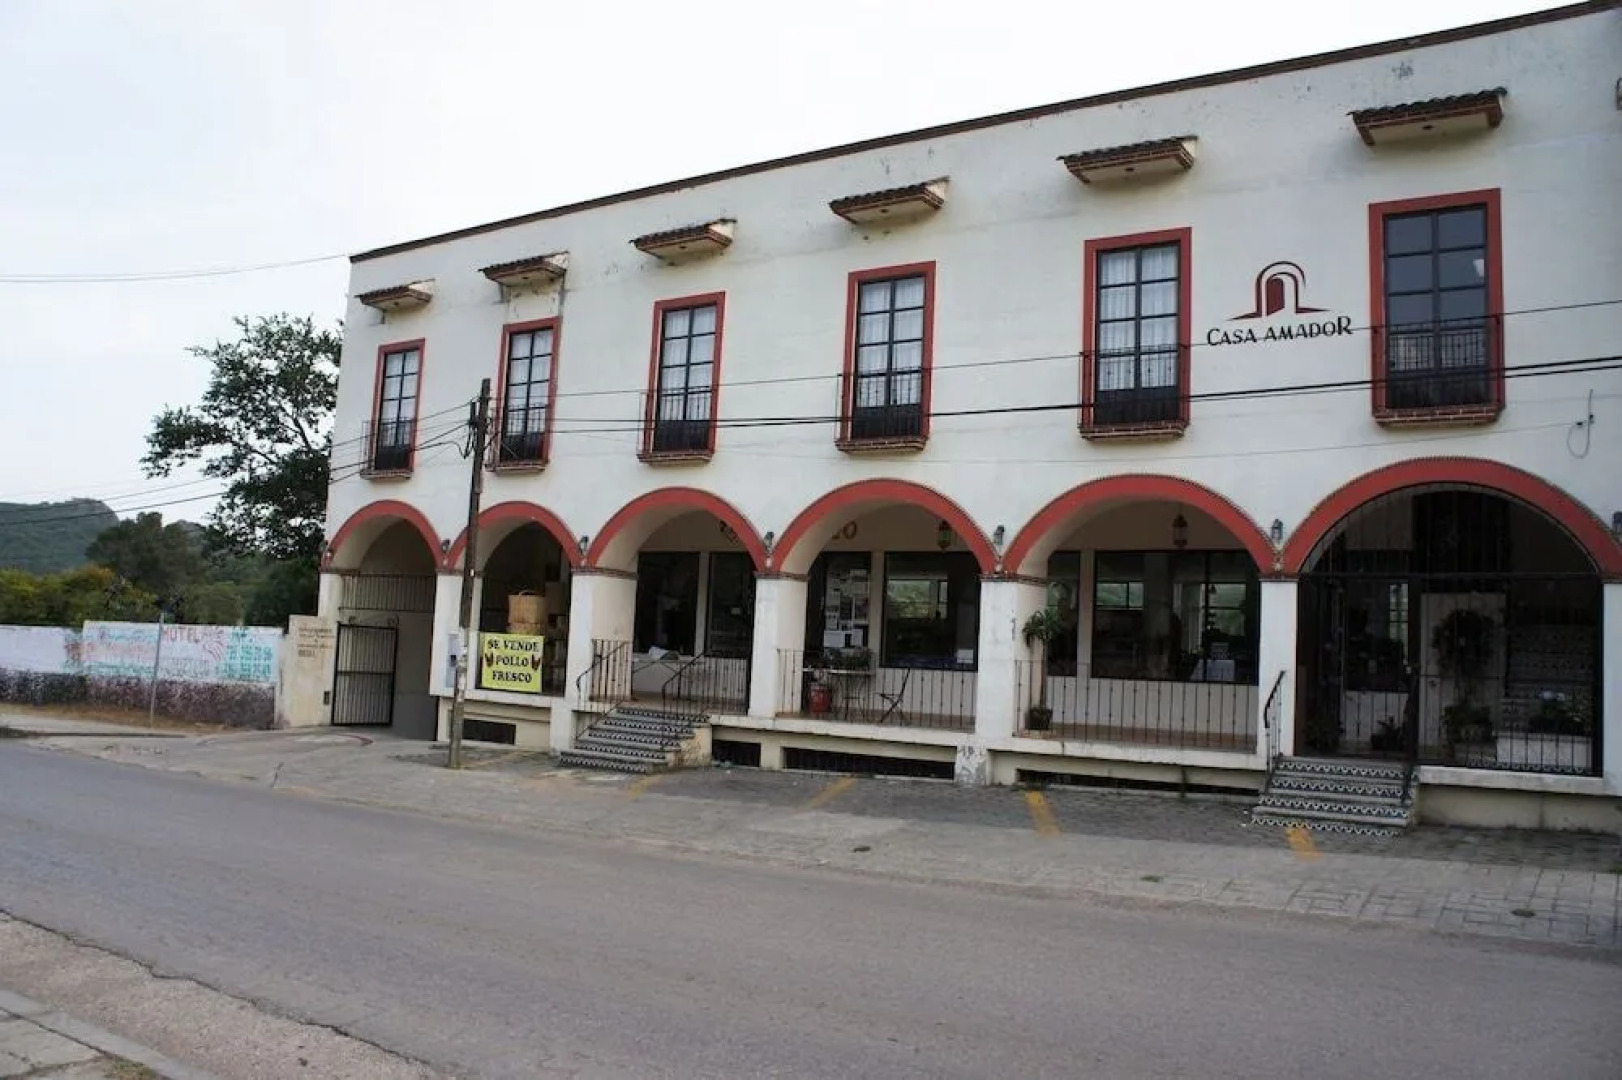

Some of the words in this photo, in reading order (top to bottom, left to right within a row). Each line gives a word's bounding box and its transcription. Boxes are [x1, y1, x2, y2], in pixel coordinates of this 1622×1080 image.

[1207, 328, 1257, 346] CASA
[1264, 315, 1353, 341] AMADOR
[487, 639, 500, 649] SE
[504, 640, 540, 652] VENDE
[495, 655, 529, 667] POLLO
[492, 670, 532, 683] FRESCO
